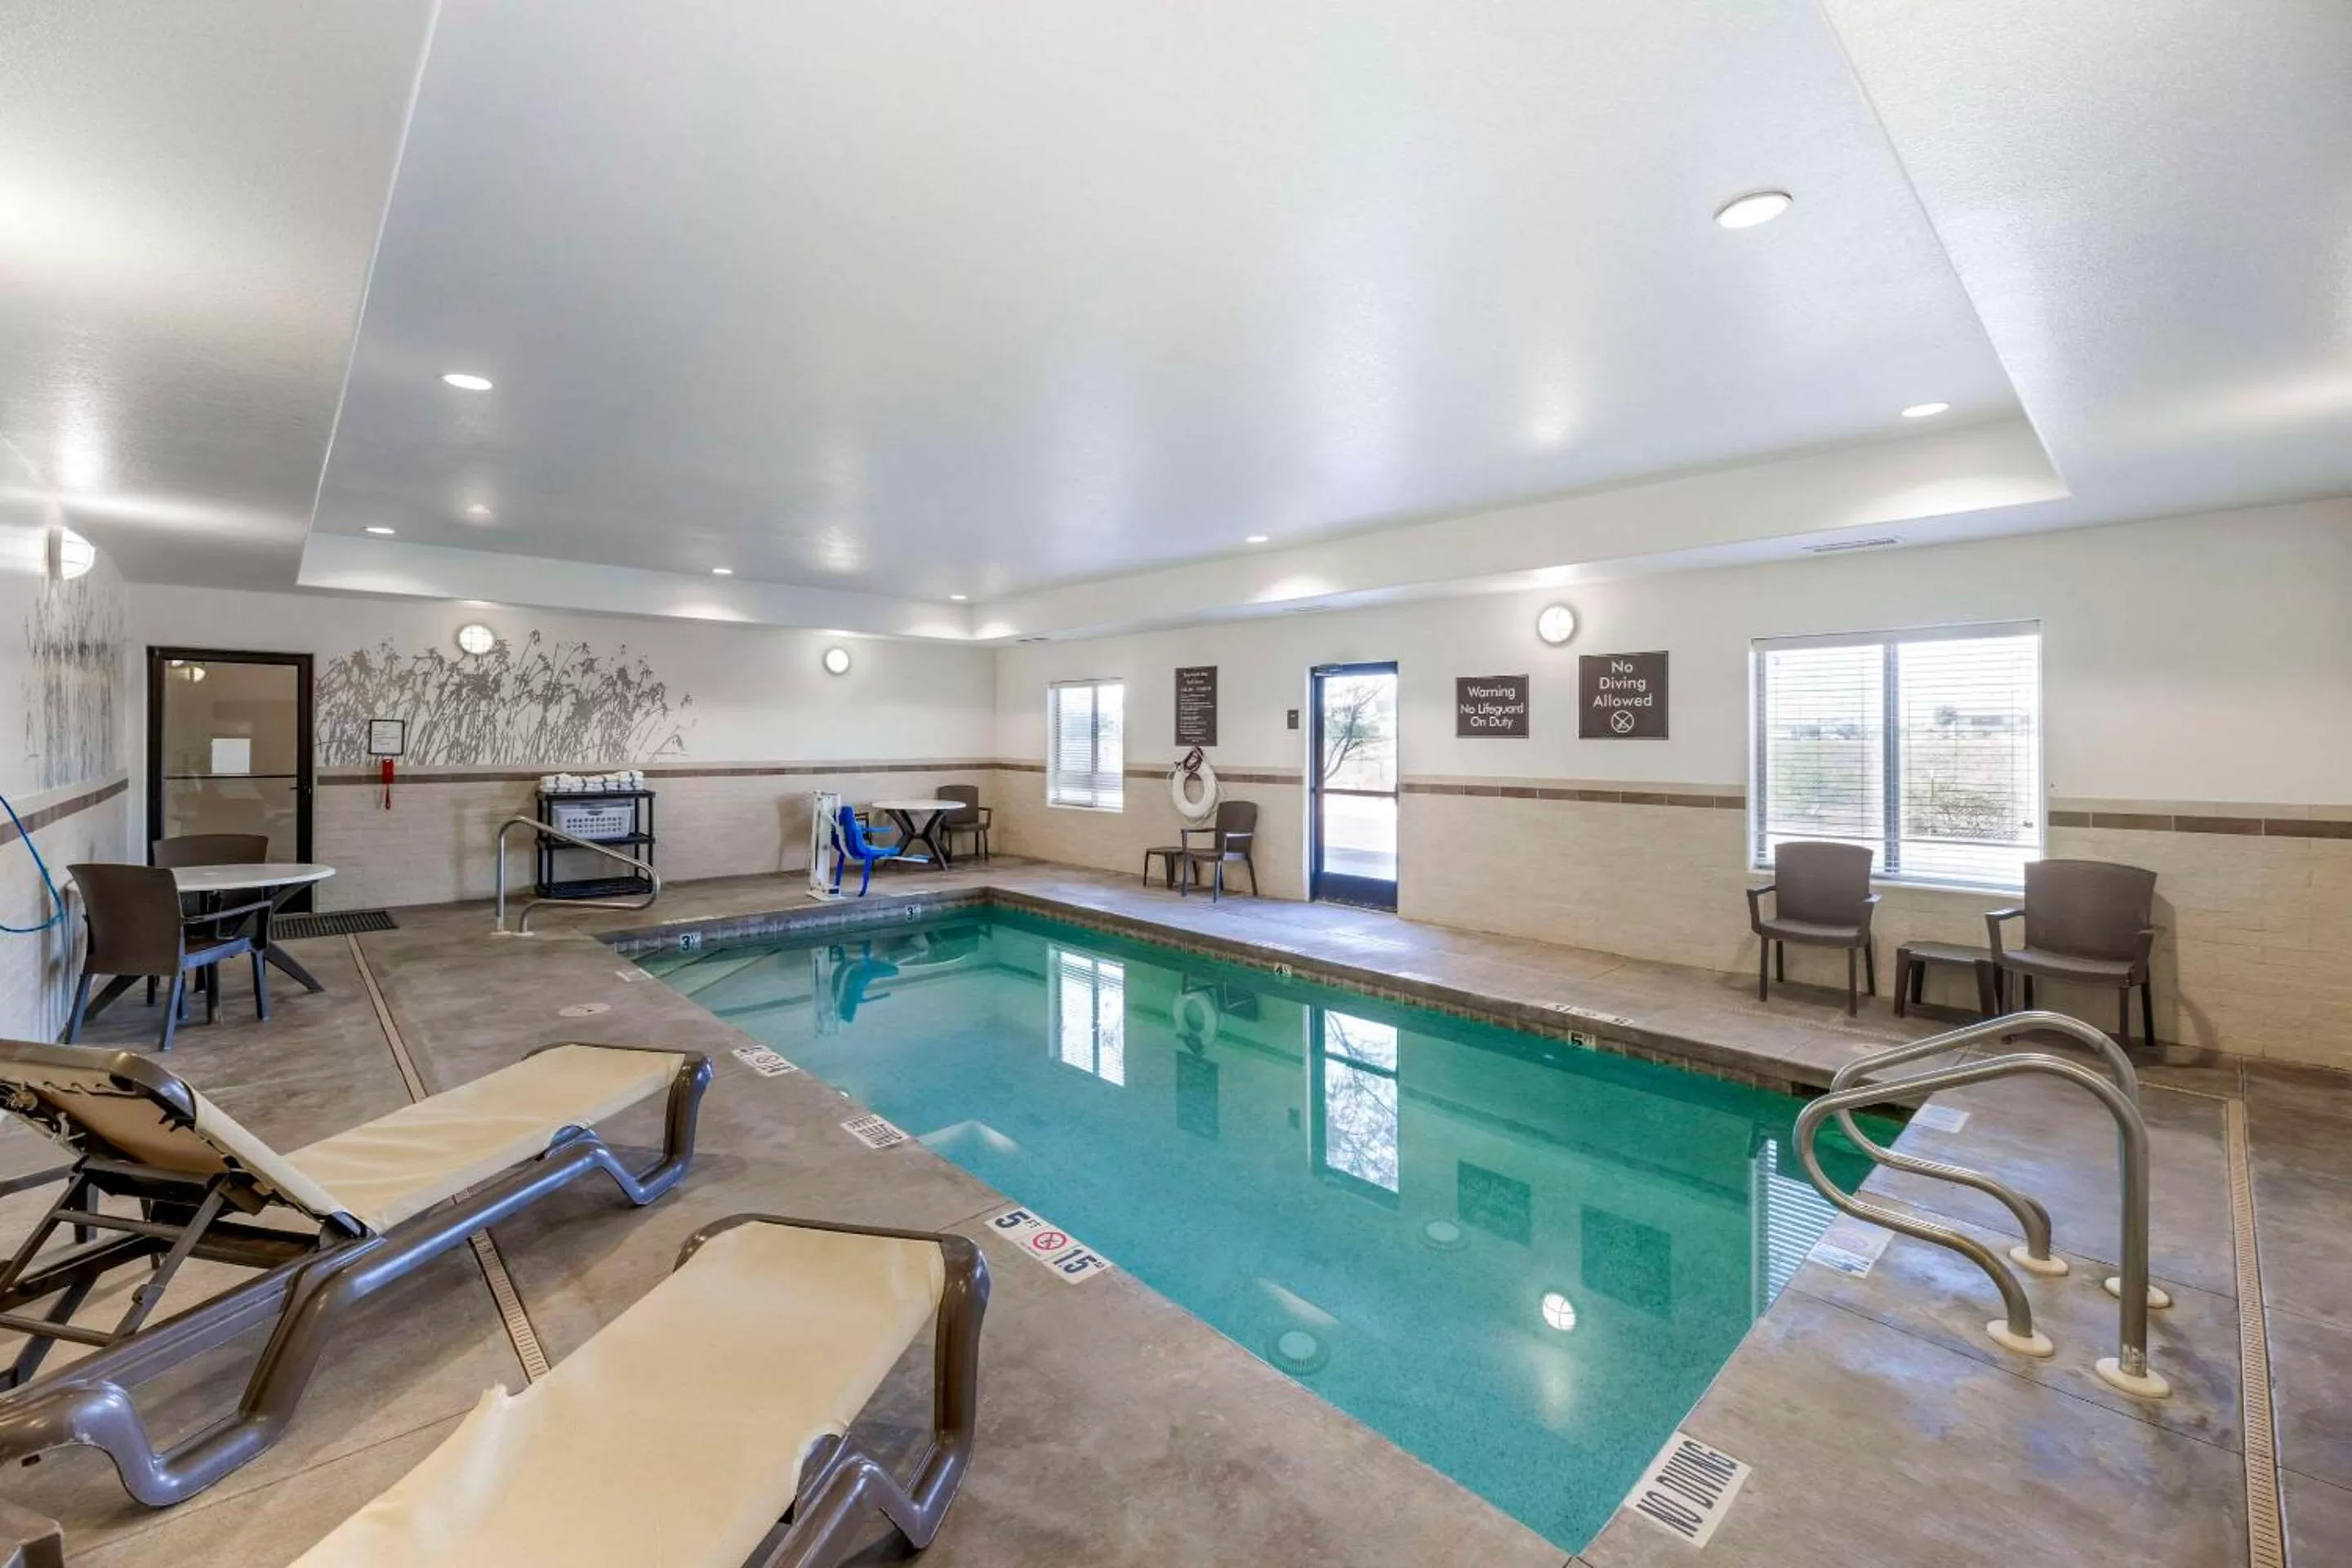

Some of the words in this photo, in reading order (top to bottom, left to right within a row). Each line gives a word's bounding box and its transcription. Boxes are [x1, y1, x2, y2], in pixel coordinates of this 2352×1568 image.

[1610, 659, 1633, 674] No
[1599, 675, 1646, 692] Diving
[1467, 685, 1516, 700] Warning
[1592, 693, 1653, 707] Allowed
[1460, 703, 1476, 715] No
[1477, 702, 1524, 716] Lifeguard
[1470, 716, 1486, 727] On
[1489, 716, 1514, 729] Duty
[995, 1211, 1031, 1228] 5
[1655, 1441, 1738, 1510] DIVING
[1636, 1491, 1704, 1539] NO
